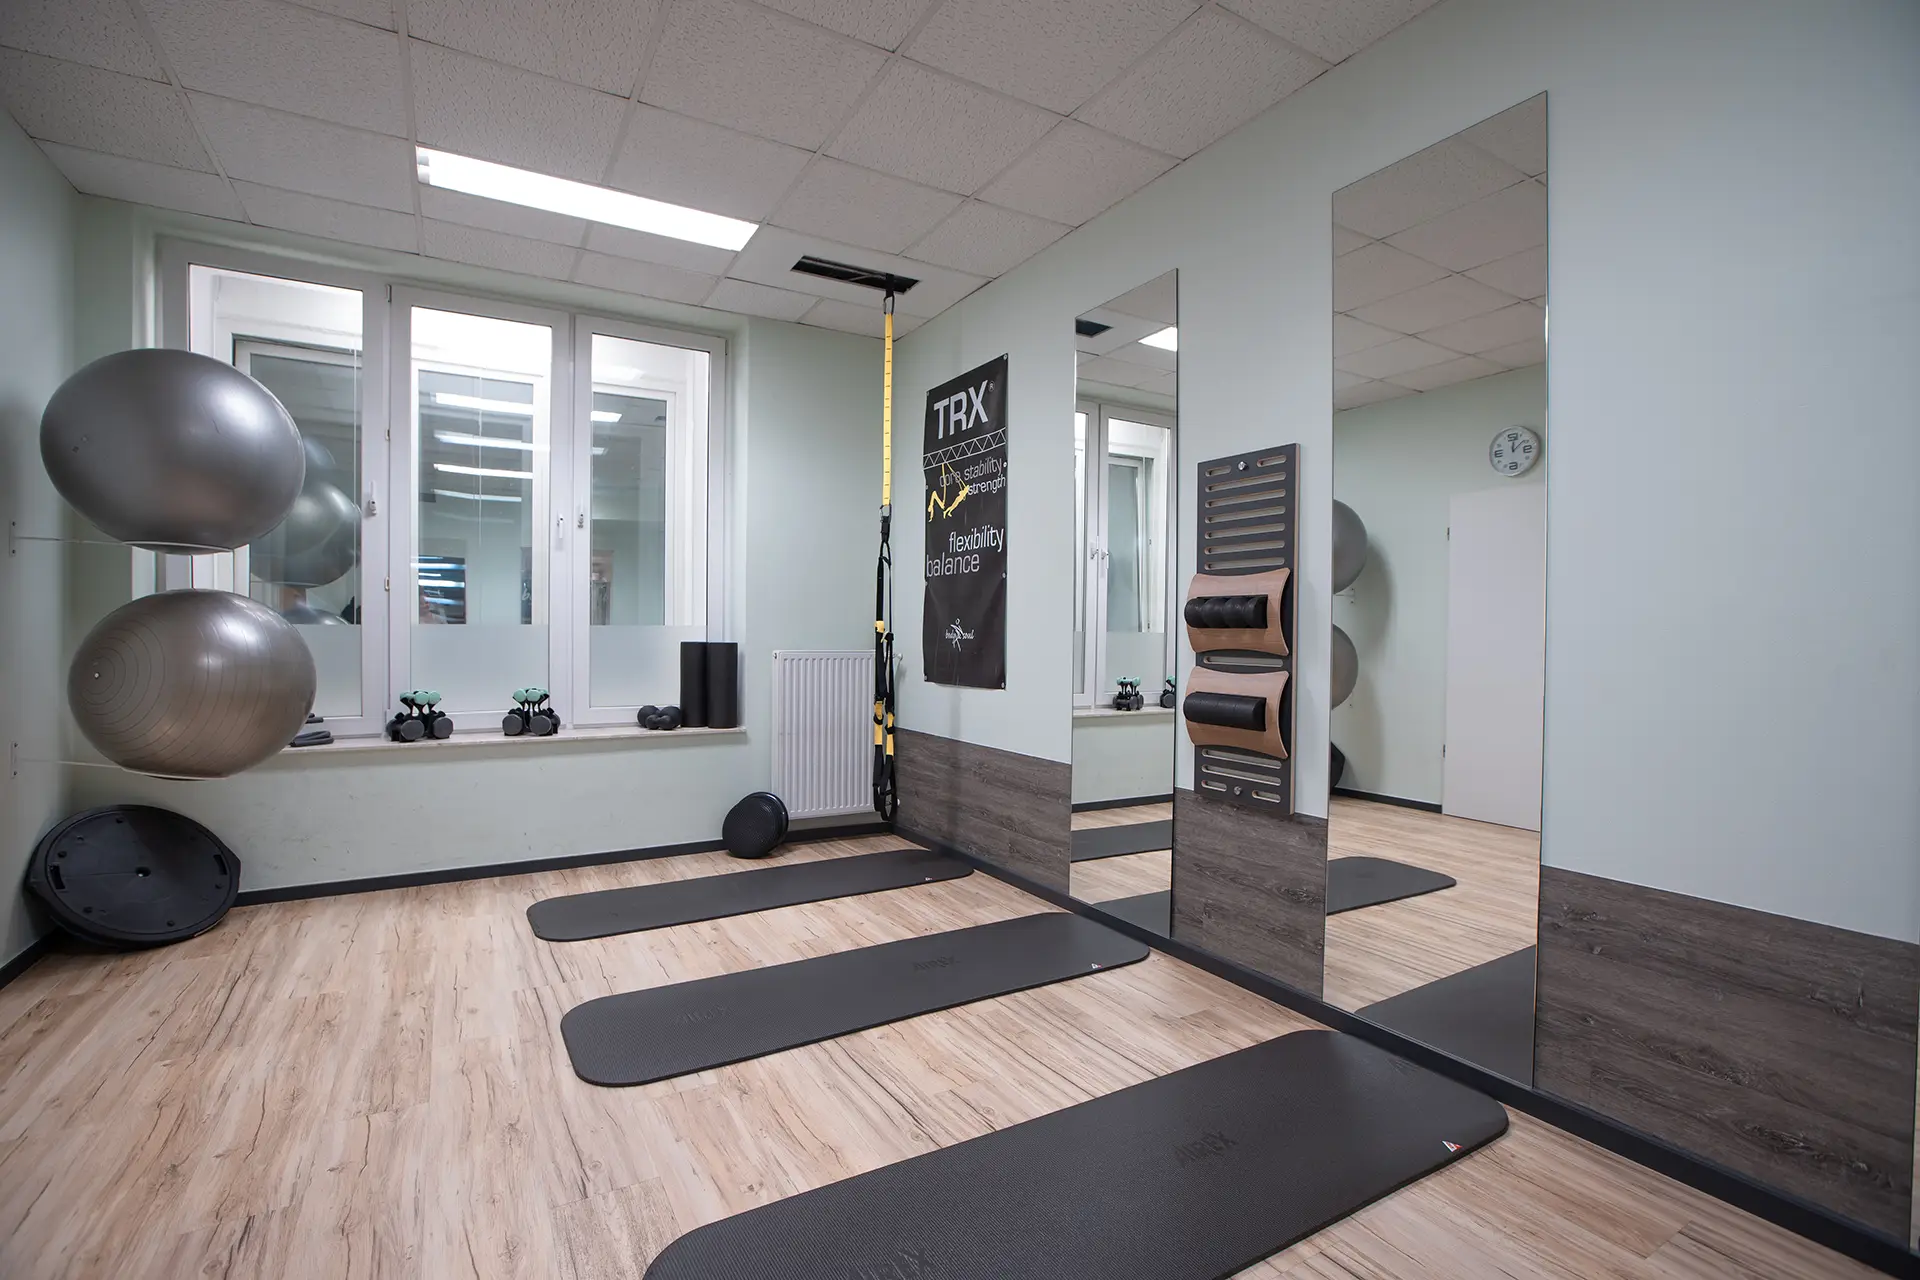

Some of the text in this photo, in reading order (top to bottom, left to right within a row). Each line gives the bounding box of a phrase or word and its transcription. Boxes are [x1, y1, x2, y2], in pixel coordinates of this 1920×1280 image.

[939, 456, 1002, 488] core stability
[967, 474, 1006, 495] strength
[949, 524, 1004, 553] flexibility
[926, 551, 980, 577] balance
